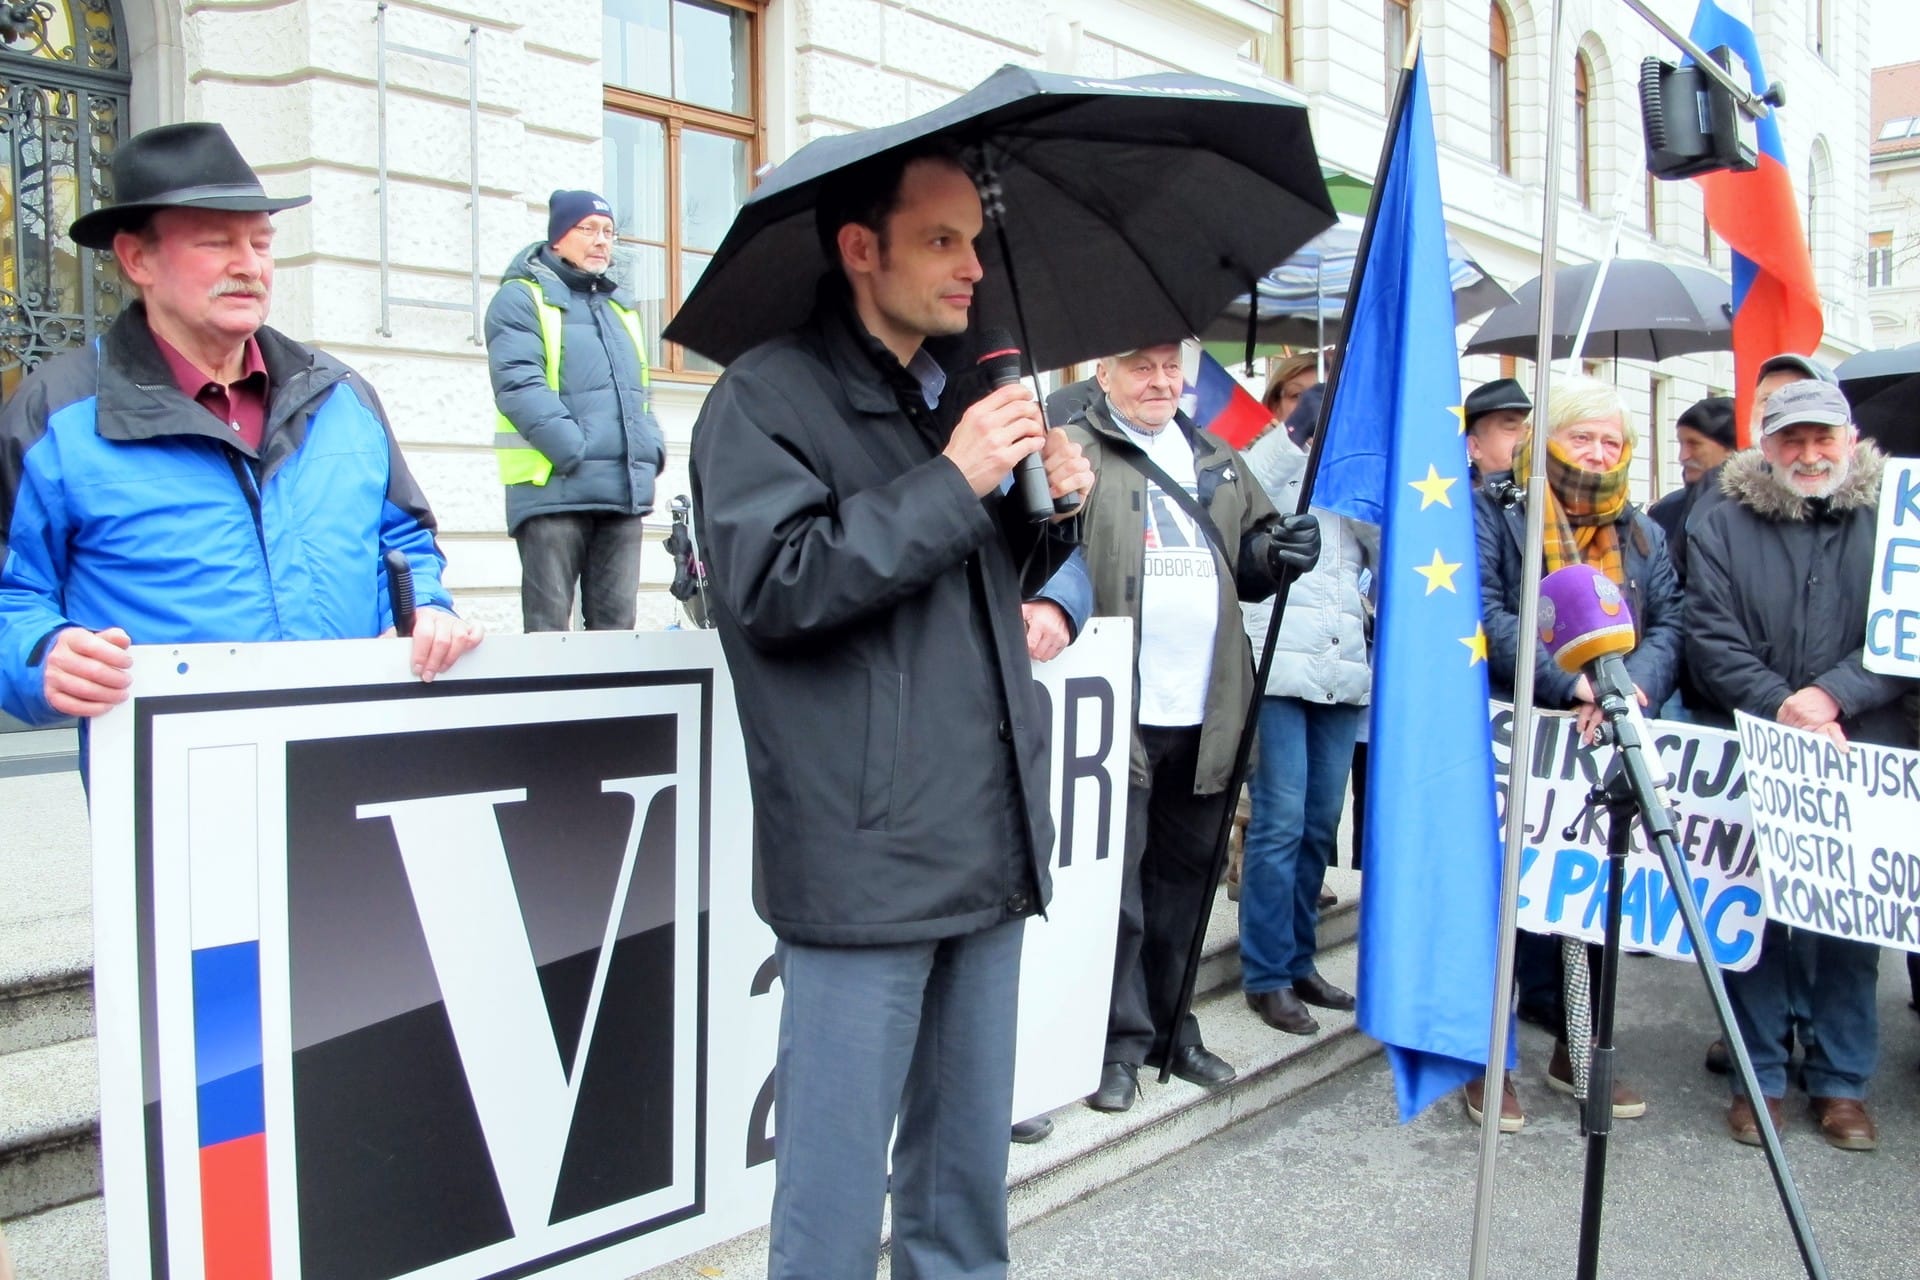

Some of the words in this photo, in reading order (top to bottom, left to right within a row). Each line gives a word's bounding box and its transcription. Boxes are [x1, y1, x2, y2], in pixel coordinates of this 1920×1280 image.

[1144, 558, 1193, 577] ODBOR
[1196, 560, 1217, 578] 201
[1866, 608, 1920, 662] CE
[1737, 717, 1920, 802] UDBOMAFIJSK
[1749, 770, 1852, 833] SODIŠČA
[1756, 820, 1856, 888] MOJSTRI
